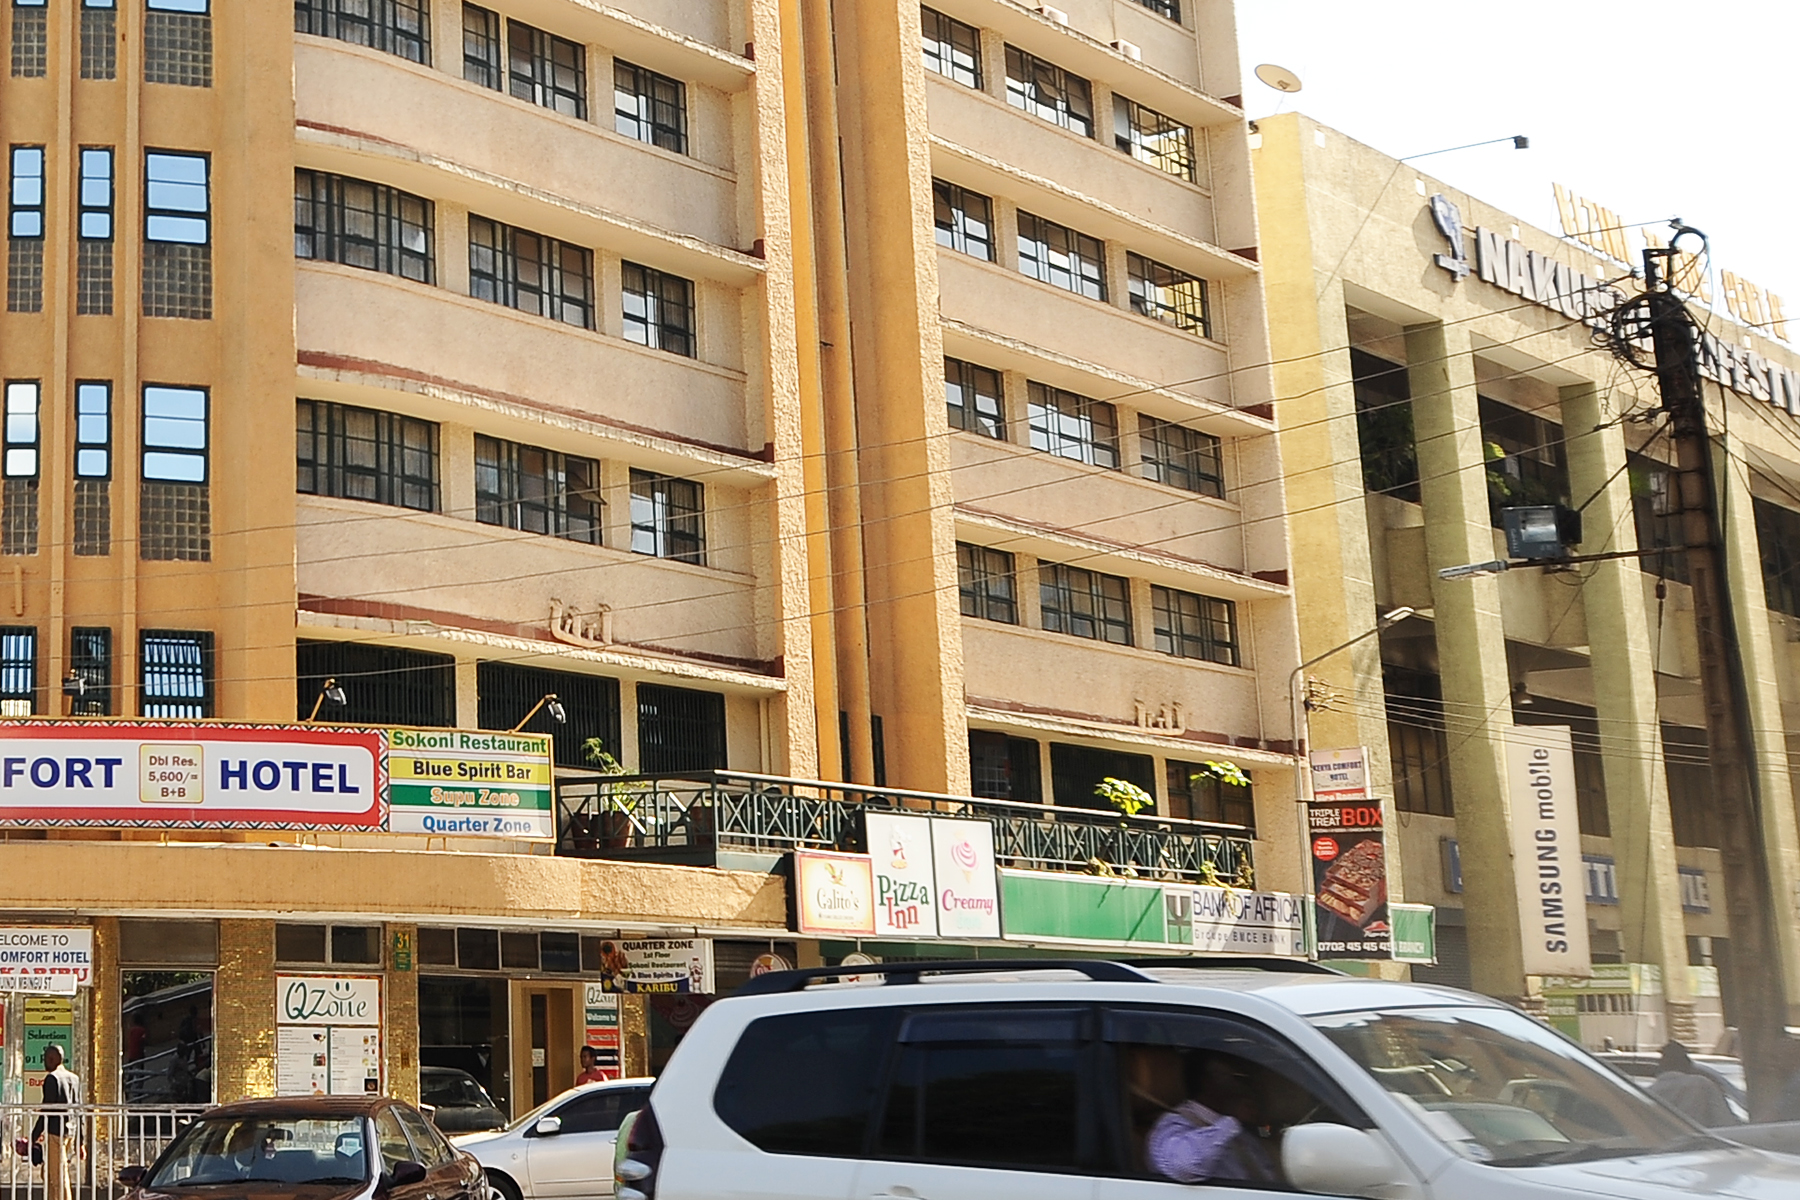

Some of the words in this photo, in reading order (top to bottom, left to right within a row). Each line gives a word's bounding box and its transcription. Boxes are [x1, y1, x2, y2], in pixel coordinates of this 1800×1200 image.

[392, 731, 454, 749] Sokoni
[459, 734, 547, 753] Restaurant
[149, 755, 169, 767] Dbl
[172, 756, 198, 767] Res.
[219, 759, 360, 795] HOTEL
[413, 761, 452, 777] Blue
[457, 762, 502, 780] Spirit
[506, 764, 531, 780] Bar
[160, 786, 186, 798] B+B
[430, 787, 475, 807] Supu
[479, 789, 520, 806] Zone
[1310, 808, 1340, 817] TRIPLE
[1341, 807, 1383, 826] BOX
[422, 815, 489, 833] Quarter
[493, 818, 531, 833] Zone
[1310, 817, 1341, 827] TREAT
[816, 887, 859, 911] Galito's
[877, 875, 929, 906] Pizza
[1535, 828, 1568, 954] SAMSUNG
[942, 889, 993, 915] Creamy
[1193, 891, 1231, 918] BANK
[1234, 894, 1251, 919] OF
[1255, 896, 1301, 923] AFRICA
[886, 897, 919, 929] Inn
[51, 934, 69, 946] TO
[396, 932, 410, 949] 31
[622, 941, 666, 951] QUARTER
[667, 940, 694, 950] ZONE
[1233, 931, 1258, 943] BMCE
[1263, 933, 1286, 944] BANK
[1318, 942, 1345, 951] 0702
[1346, 942, 1361, 951] 45
[1363, 942, 1378, 951] 45
[53, 951, 89, 963] HOTEL
[651, 961, 686, 969] Restaurant
[636, 983, 678, 993] KARIBU
[27, 1029, 67, 1040] Selection
